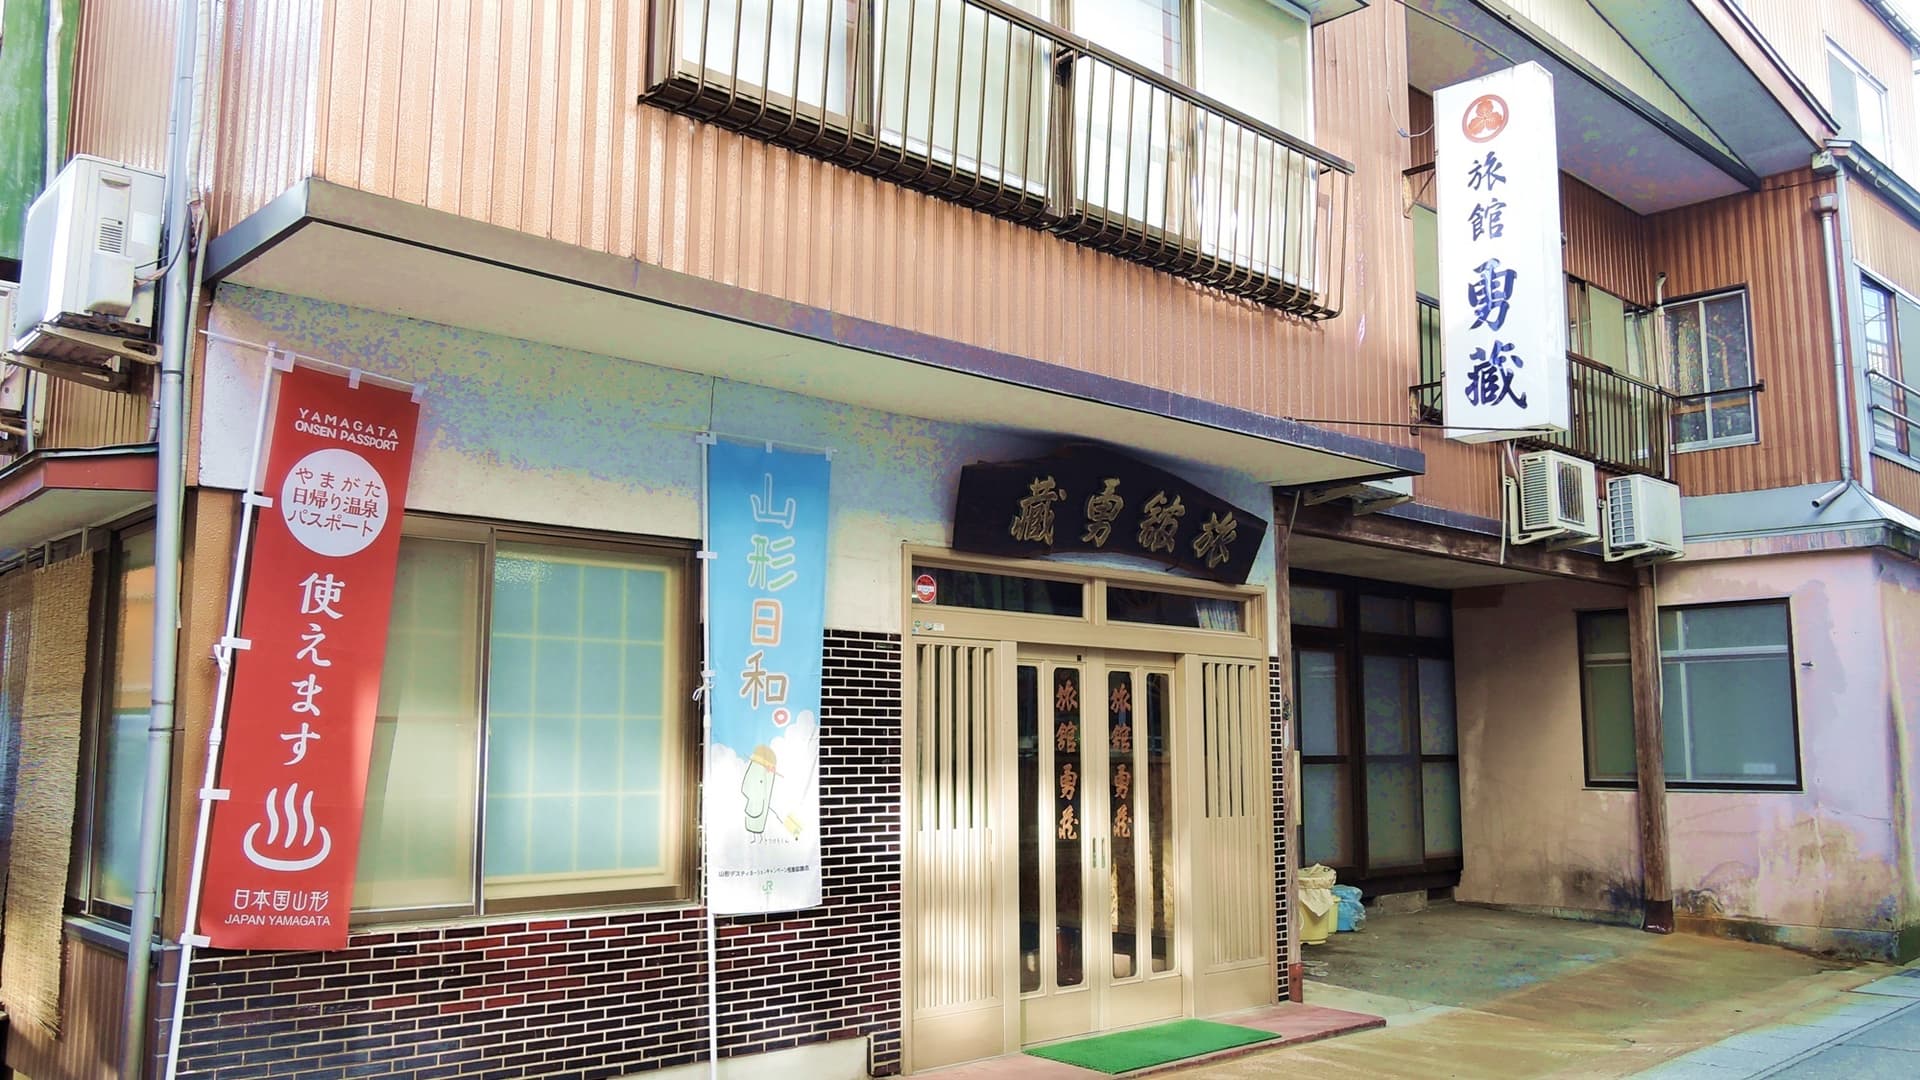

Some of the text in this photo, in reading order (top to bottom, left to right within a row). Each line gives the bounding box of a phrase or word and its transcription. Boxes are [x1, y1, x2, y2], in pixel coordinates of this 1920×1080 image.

[295, 420, 399, 451] ONSEN PASSPORT
[299, 408, 398, 439] YAMAGATA
[296, 468, 381, 498] やまがた
[293, 487, 379, 518] 日帰り温泉
[288, 510, 373, 537] パスポート
[280, 572, 346, 766] 使えます
[234, 889, 329, 912] 日本国山形
[224, 914, 331, 926] JAPAN YAMAGATA
